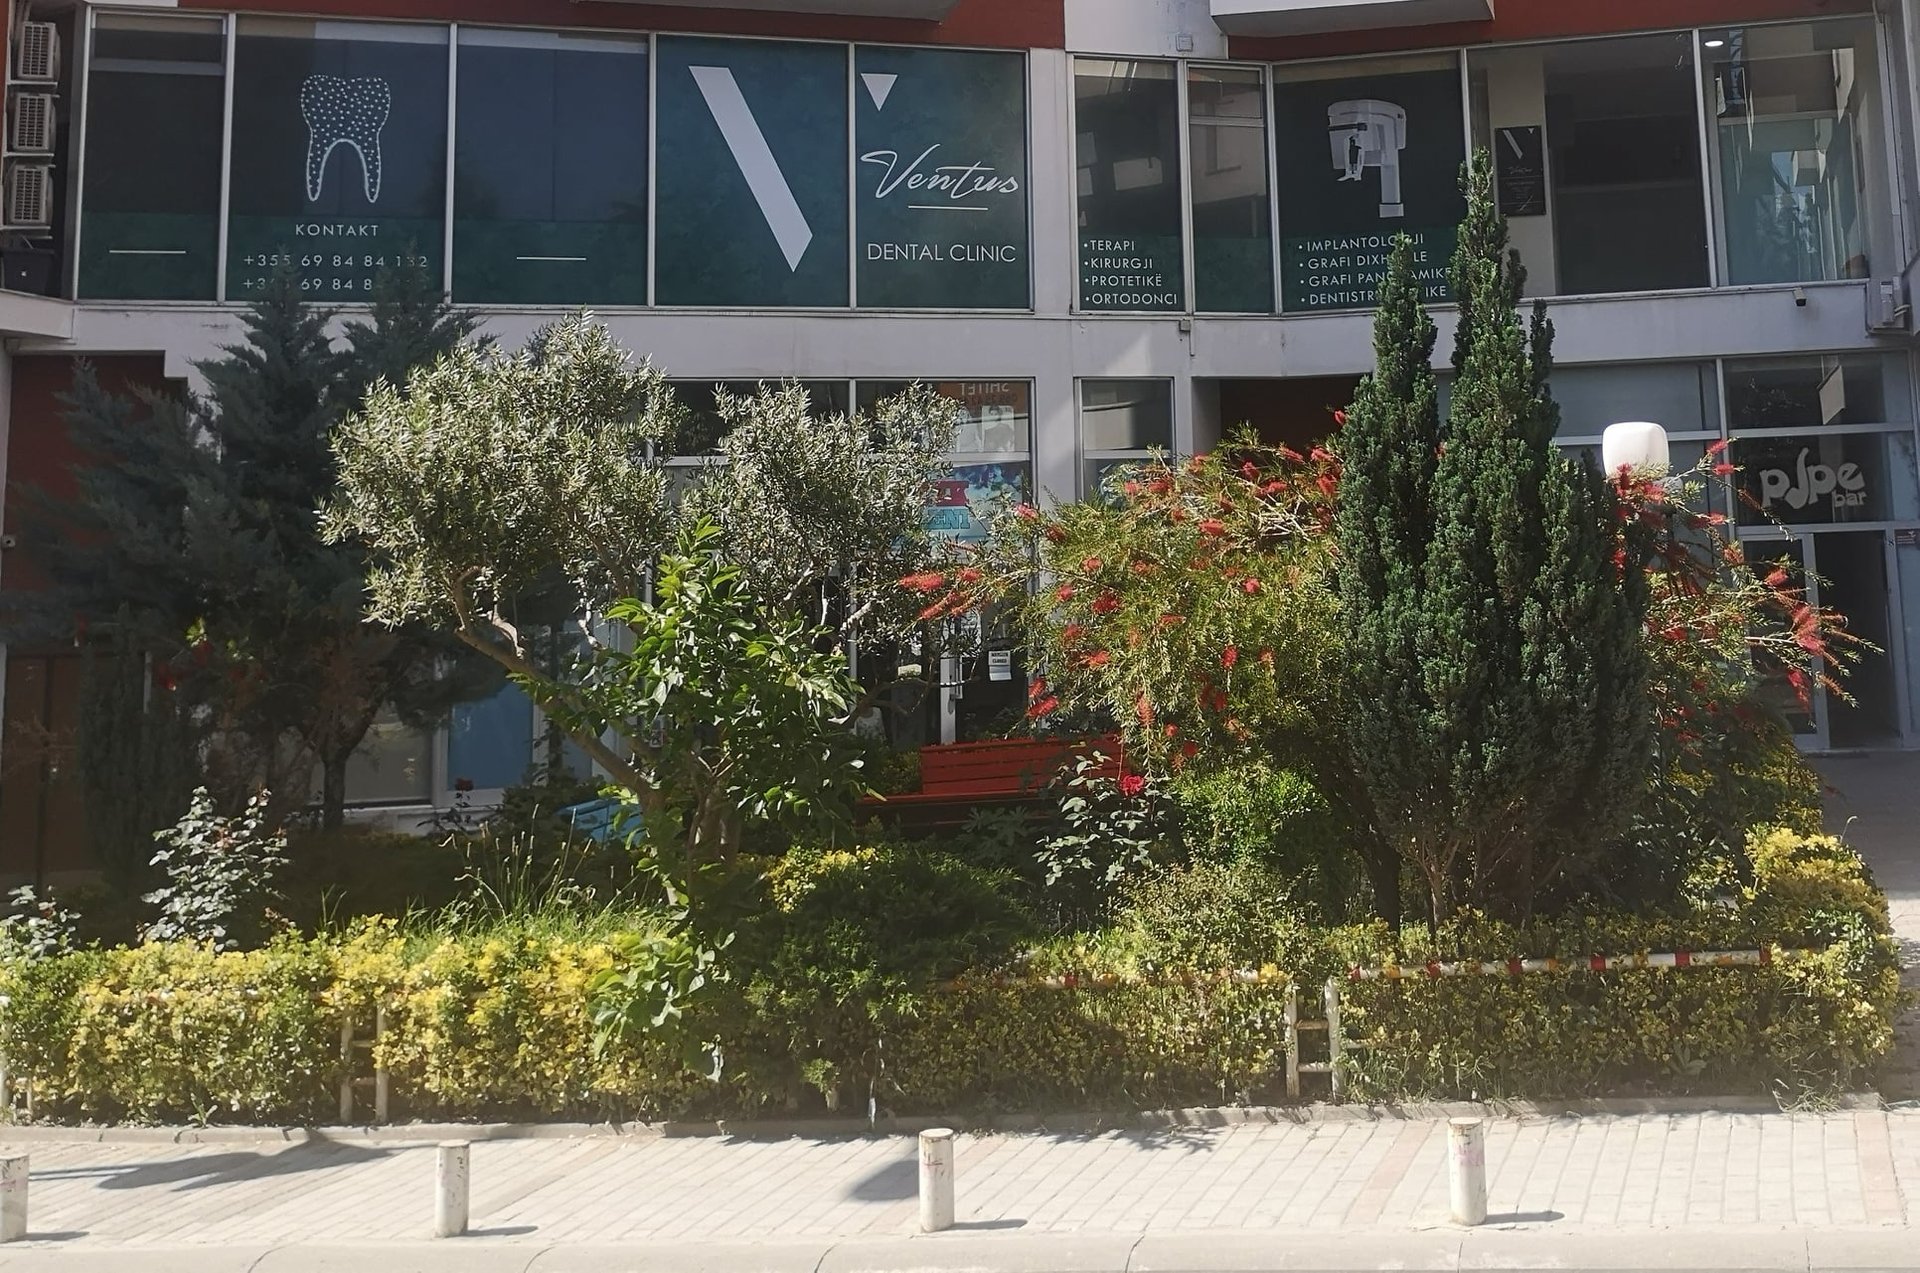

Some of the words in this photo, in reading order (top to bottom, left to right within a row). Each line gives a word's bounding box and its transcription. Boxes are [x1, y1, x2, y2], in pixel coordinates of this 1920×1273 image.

[860, 143, 1019, 199] Ventus
[295, 223, 379, 237] KONTAKT
[1090, 240, 1135, 251] TERAPI
[1307, 233, 1424, 252] IMPLANTOLOJI
[867, 243, 944, 261] DENTAL
[949, 244, 1016, 263] CLINIC
[243, 254, 292, 267] +355
[301, 254, 323, 267] 69
[332, 255, 354, 267] 84
[364, 255, 385, 267] 84
[1091, 257, 1153, 269] KIRURGJI
[1308, 256, 1351, 270] GRAFI
[1356, 251, 1428, 266] DIXHLE
[301, 278, 323, 291] 69
[332, 278, 354, 291] 84
[1091, 273, 1162, 287] PROTETIKË
[1309, 273, 1351, 287] GRAFI
[1092, 293, 1178, 305] ORTODONCI
[1310, 290, 1378, 305] DENTISTR
[1831, 489, 1867, 508] bar
